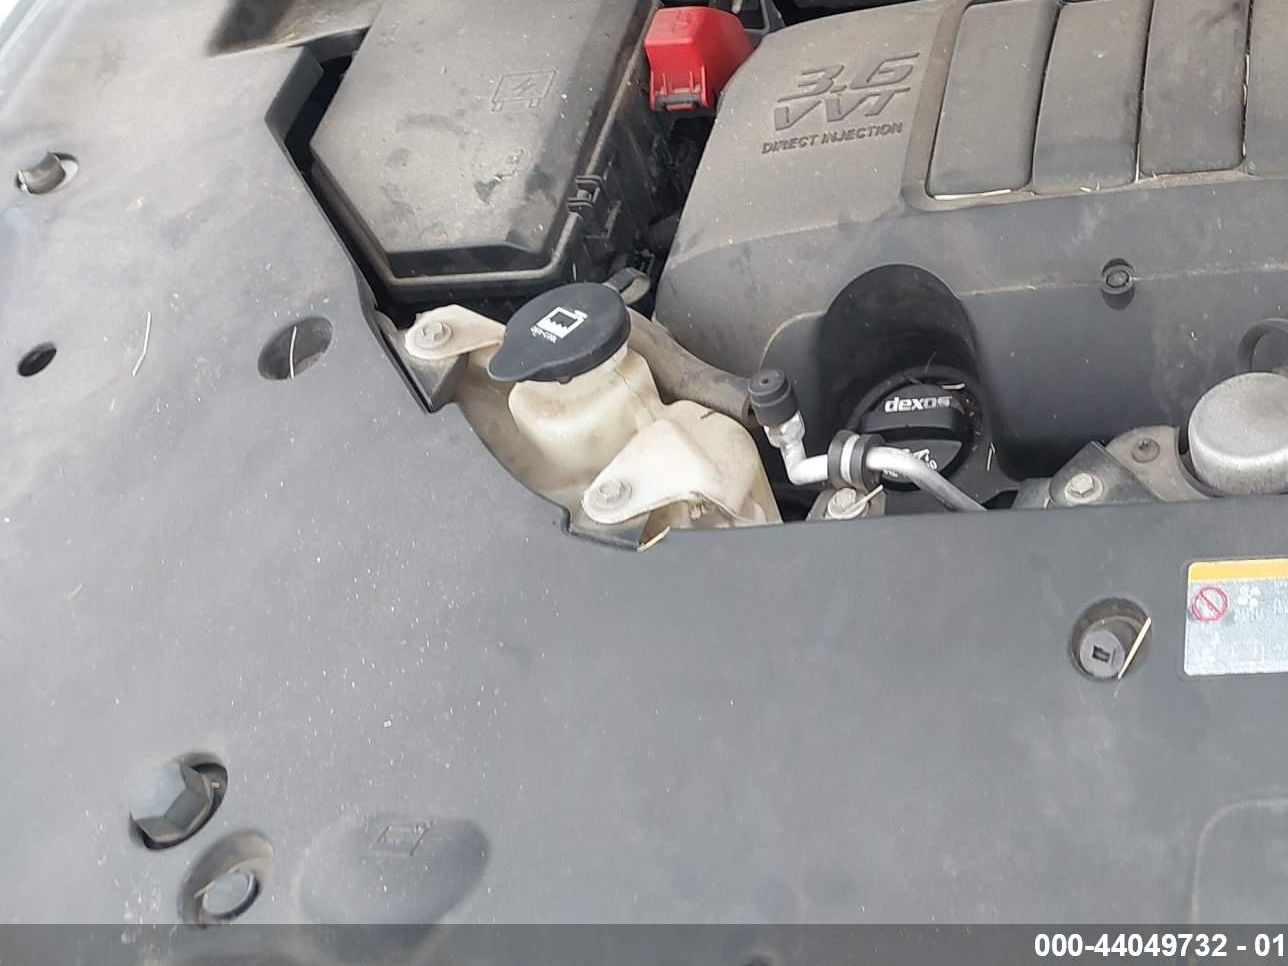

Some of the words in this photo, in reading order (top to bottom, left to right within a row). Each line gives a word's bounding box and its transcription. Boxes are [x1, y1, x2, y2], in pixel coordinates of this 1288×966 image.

[777, 52, 920, 103] 3.6
[774, 87, 911, 131] VVT
[761, 134, 818, 154] DIRECT
[821, 122, 903, 146] INJECTION
[884, 395, 952, 413] dexos
